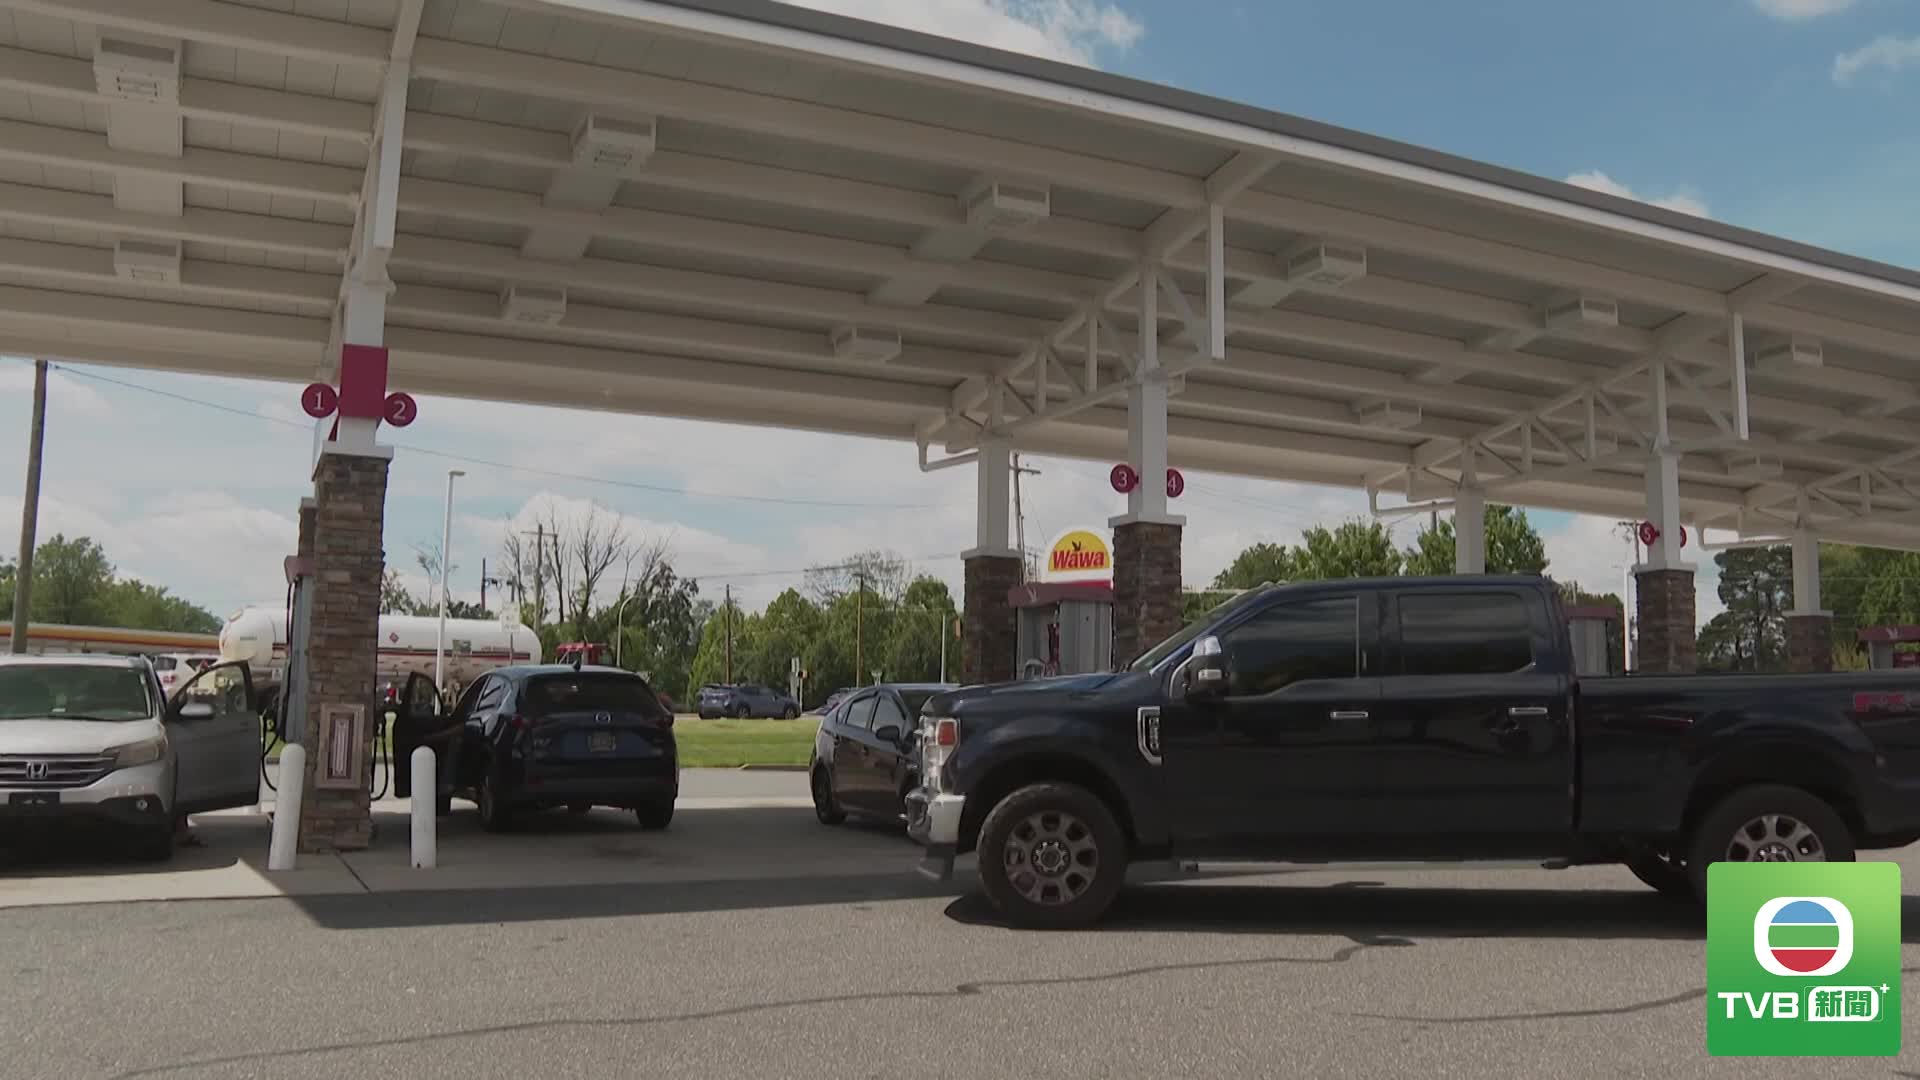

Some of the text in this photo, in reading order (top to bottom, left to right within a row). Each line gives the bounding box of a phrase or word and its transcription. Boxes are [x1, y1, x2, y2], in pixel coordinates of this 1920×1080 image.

[313, 391, 324, 411] 1
[393, 400, 406, 420] 2
[1118, 471, 1128, 488] 3
[1167, 475, 1177, 492] 4
[1053, 550, 1104, 569] Wawa
